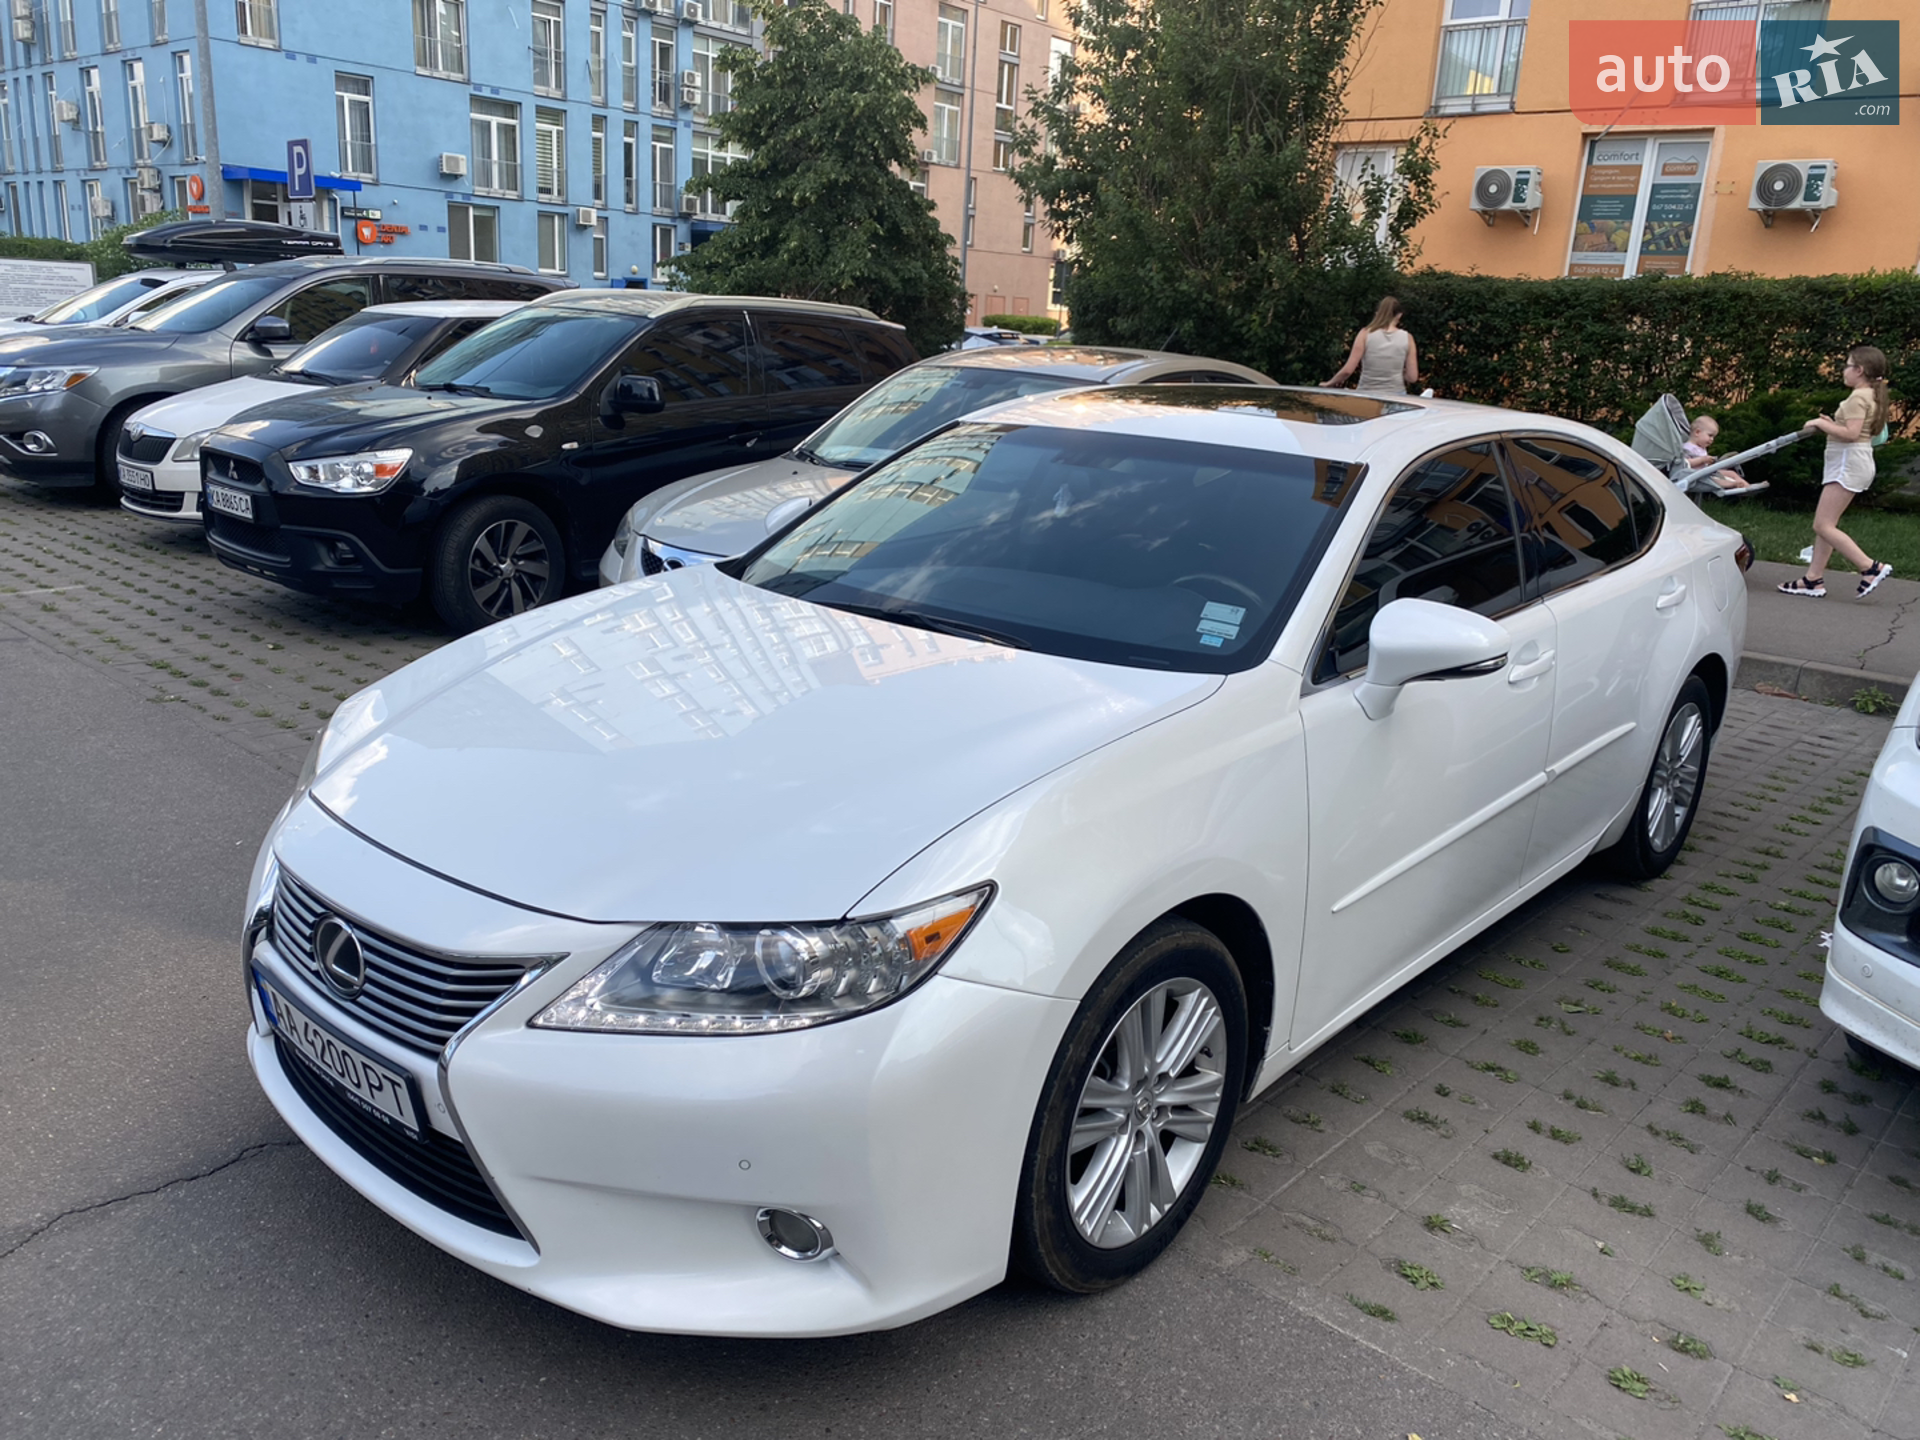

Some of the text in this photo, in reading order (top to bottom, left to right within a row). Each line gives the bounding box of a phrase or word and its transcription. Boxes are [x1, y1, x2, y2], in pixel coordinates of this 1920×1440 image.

[1596, 152, 1639, 162] comfort
[292, 145, 307, 191] P
[1665, 163, 1697, 172] comfort
